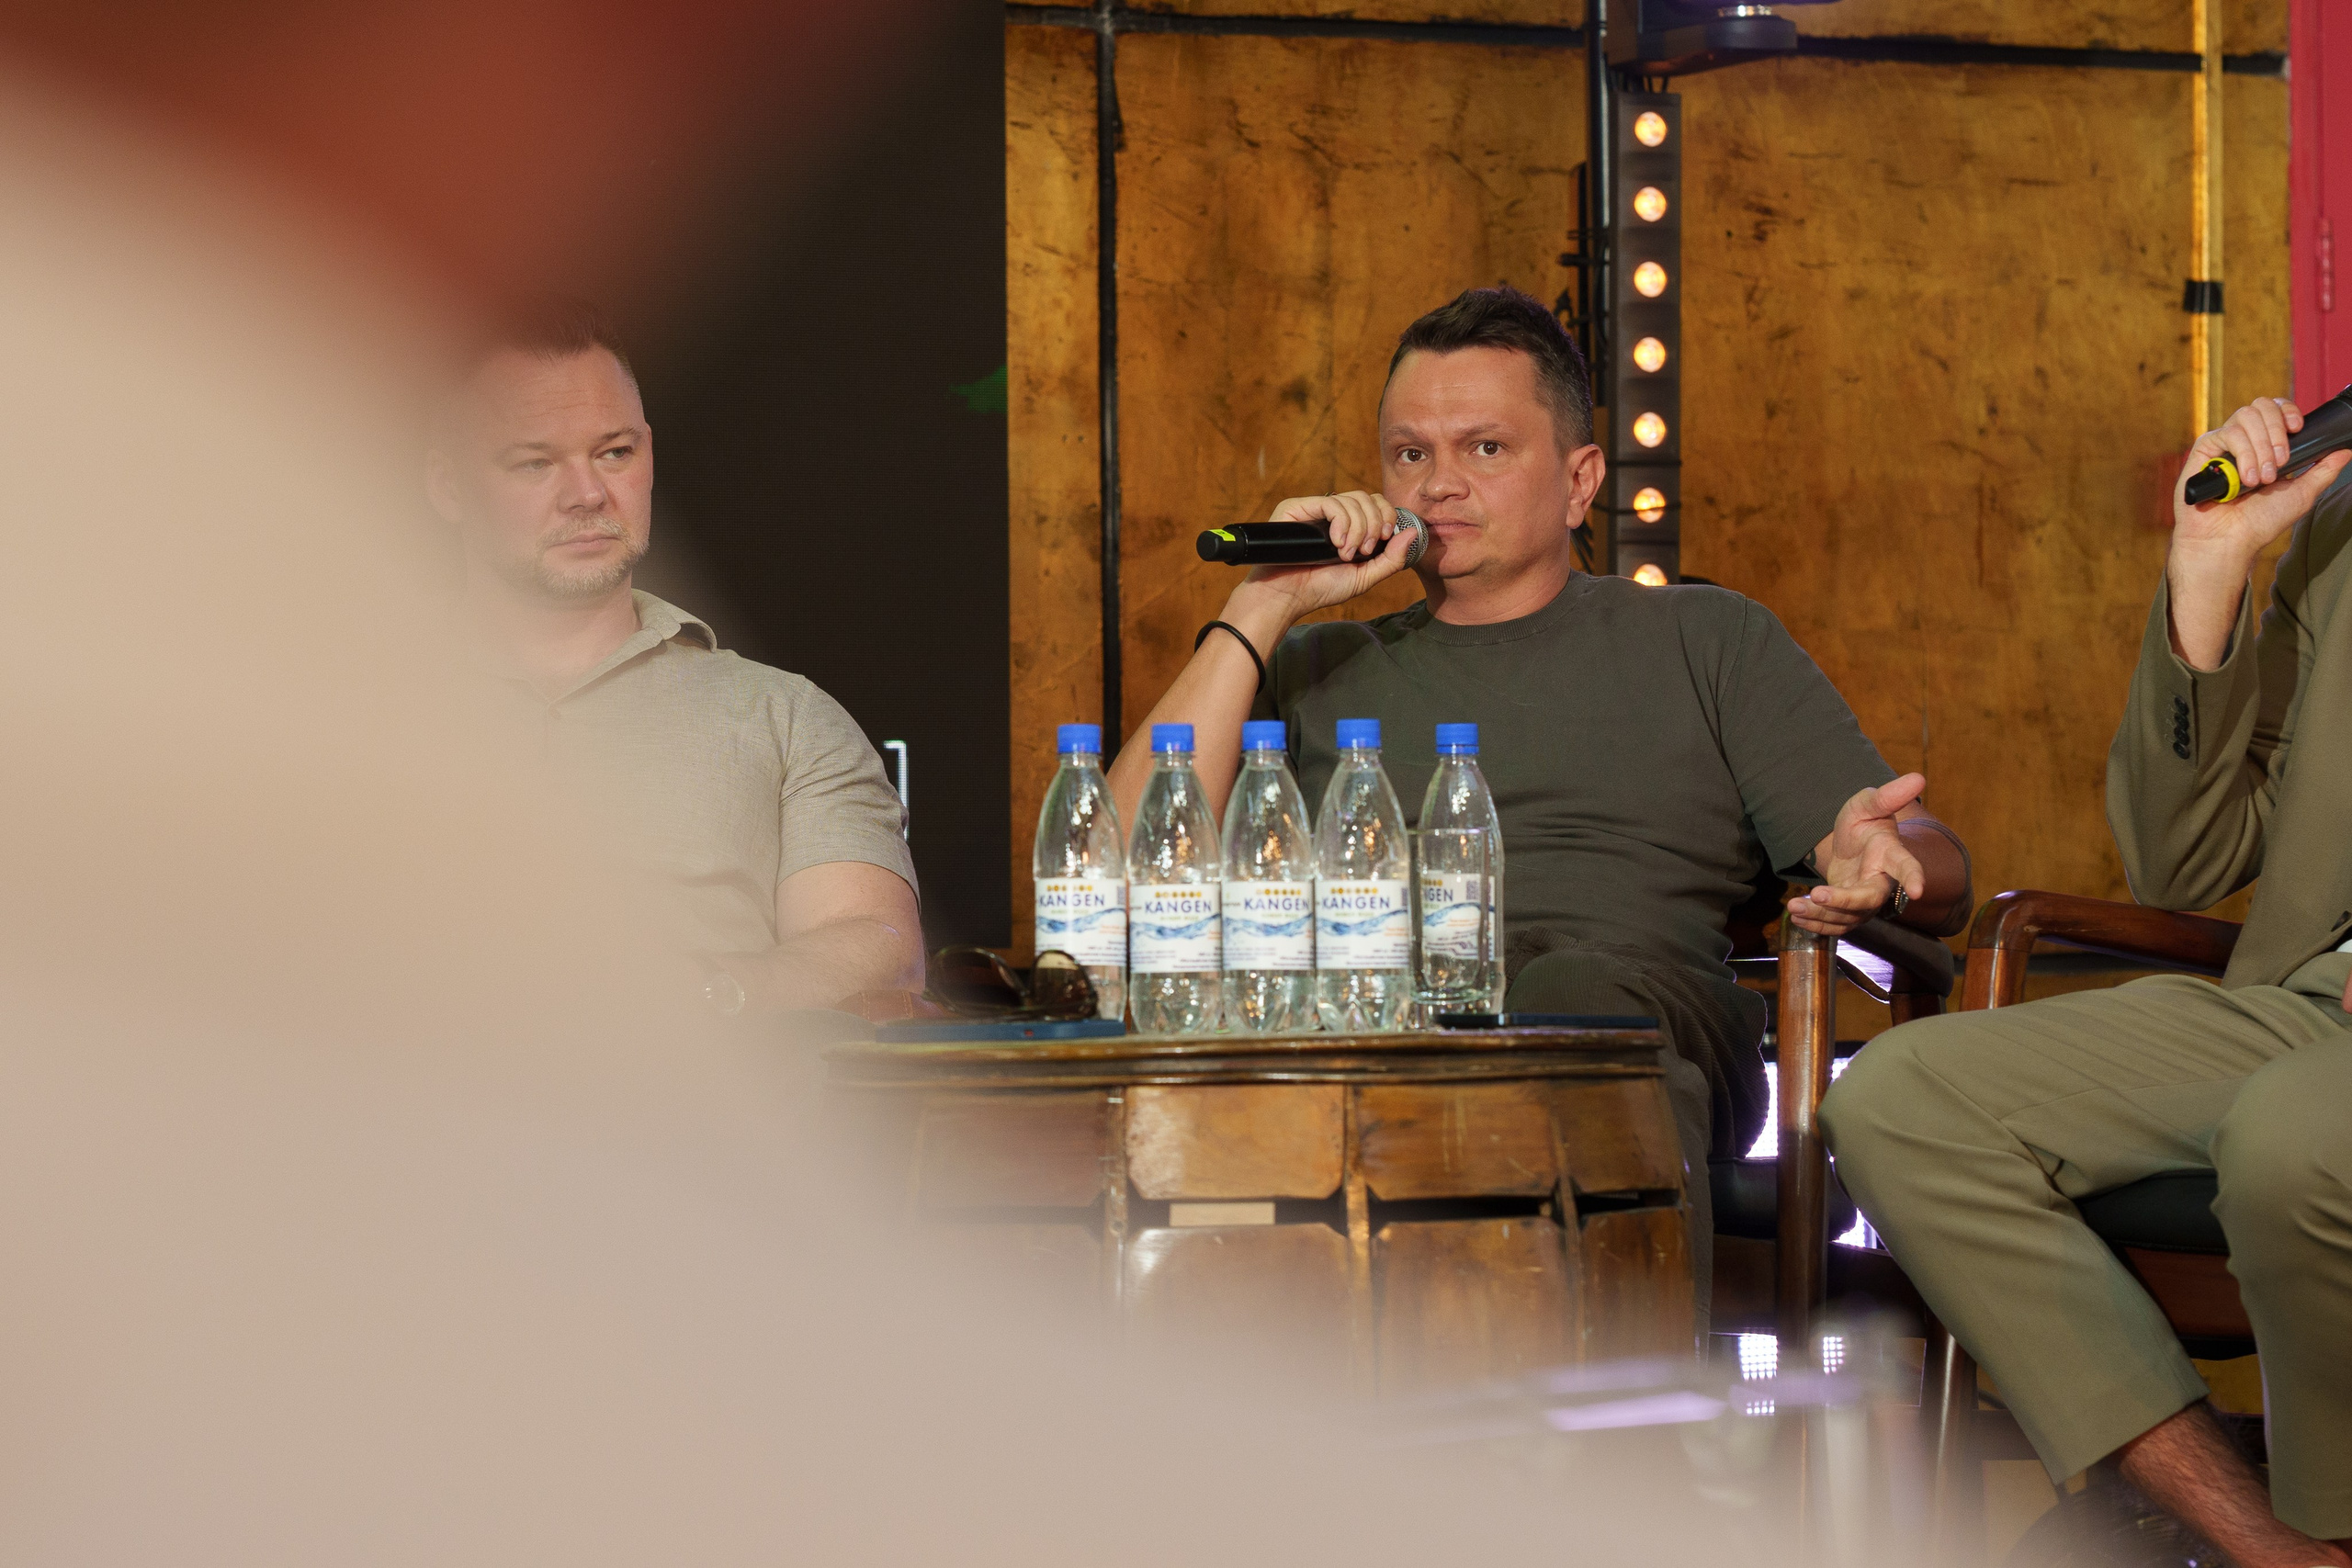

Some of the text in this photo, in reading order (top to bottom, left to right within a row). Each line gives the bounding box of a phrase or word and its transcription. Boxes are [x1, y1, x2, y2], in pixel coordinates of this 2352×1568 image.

[1039, 894, 1104, 907] KANGEN
[1145, 900, 1212, 913] KANGEN
[1244, 898, 1309, 910] KANGEN
[1322, 896, 1389, 908] KANGEN
